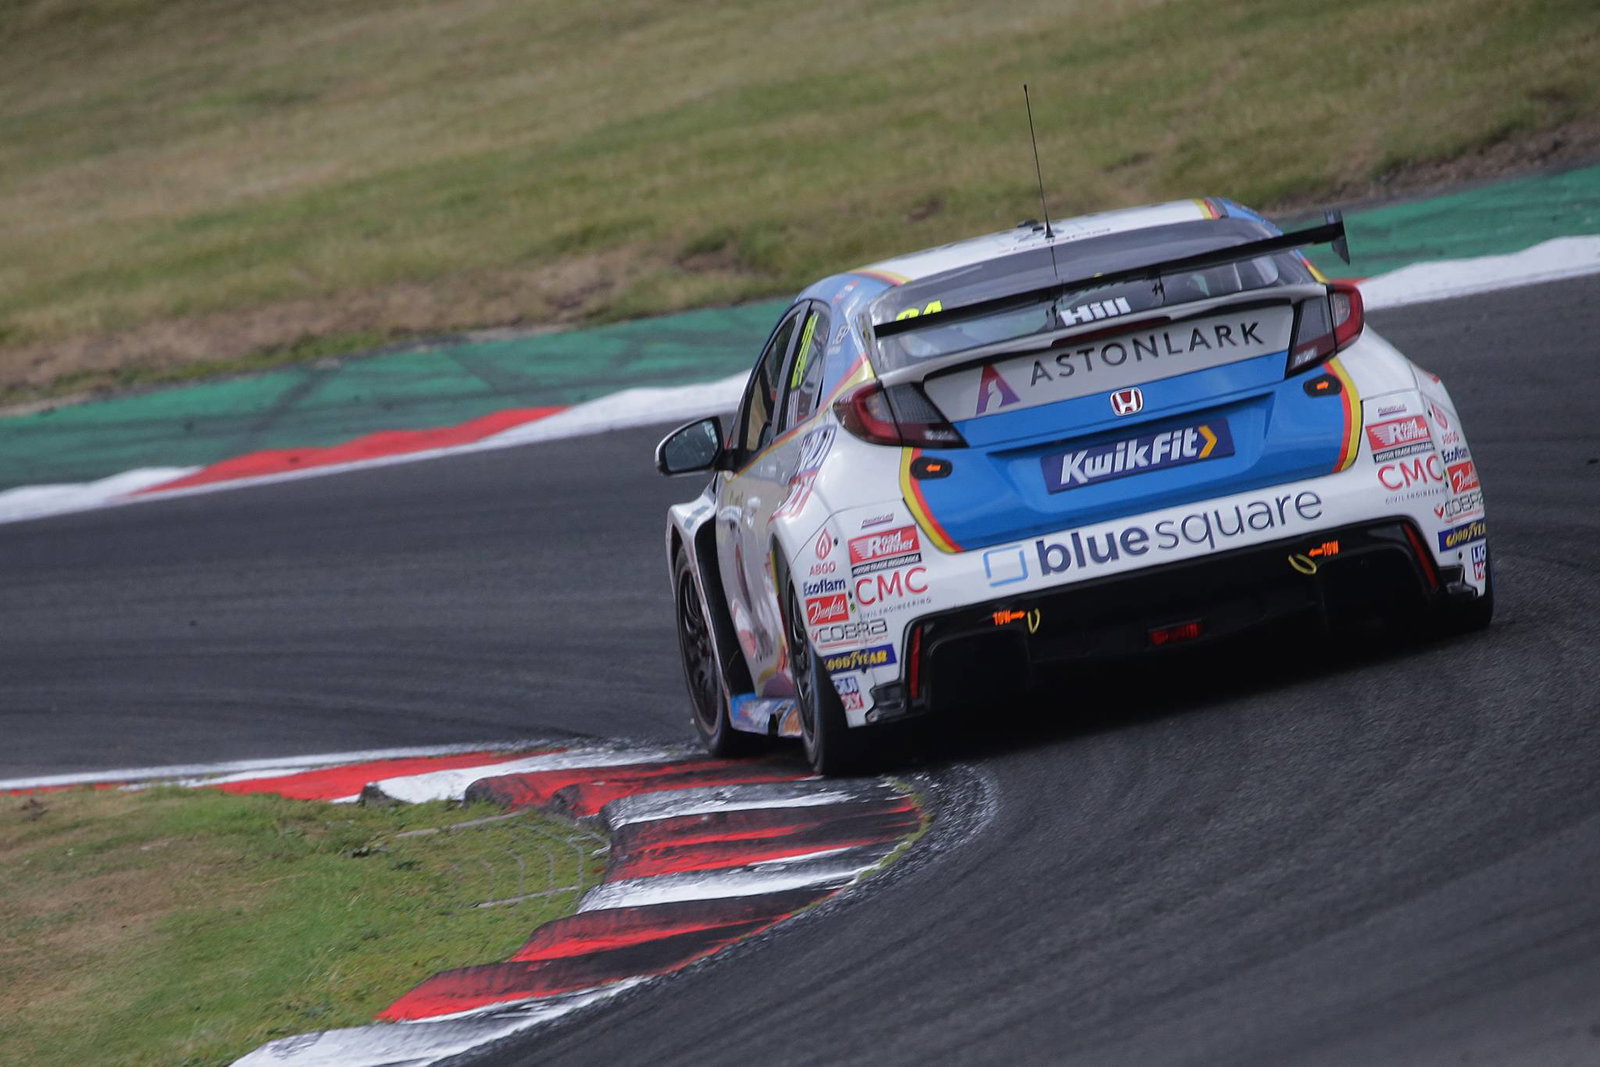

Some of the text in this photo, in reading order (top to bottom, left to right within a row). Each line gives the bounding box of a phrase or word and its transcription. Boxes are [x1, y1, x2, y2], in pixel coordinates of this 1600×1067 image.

[1060, 297, 1131, 326] Hill
[1030, 321, 1264, 386] ASTONLARK
[1377, 454, 1444, 491] CMC
[803, 578, 846, 598] Ecoflam
[856, 566, 929, 606] CMC
